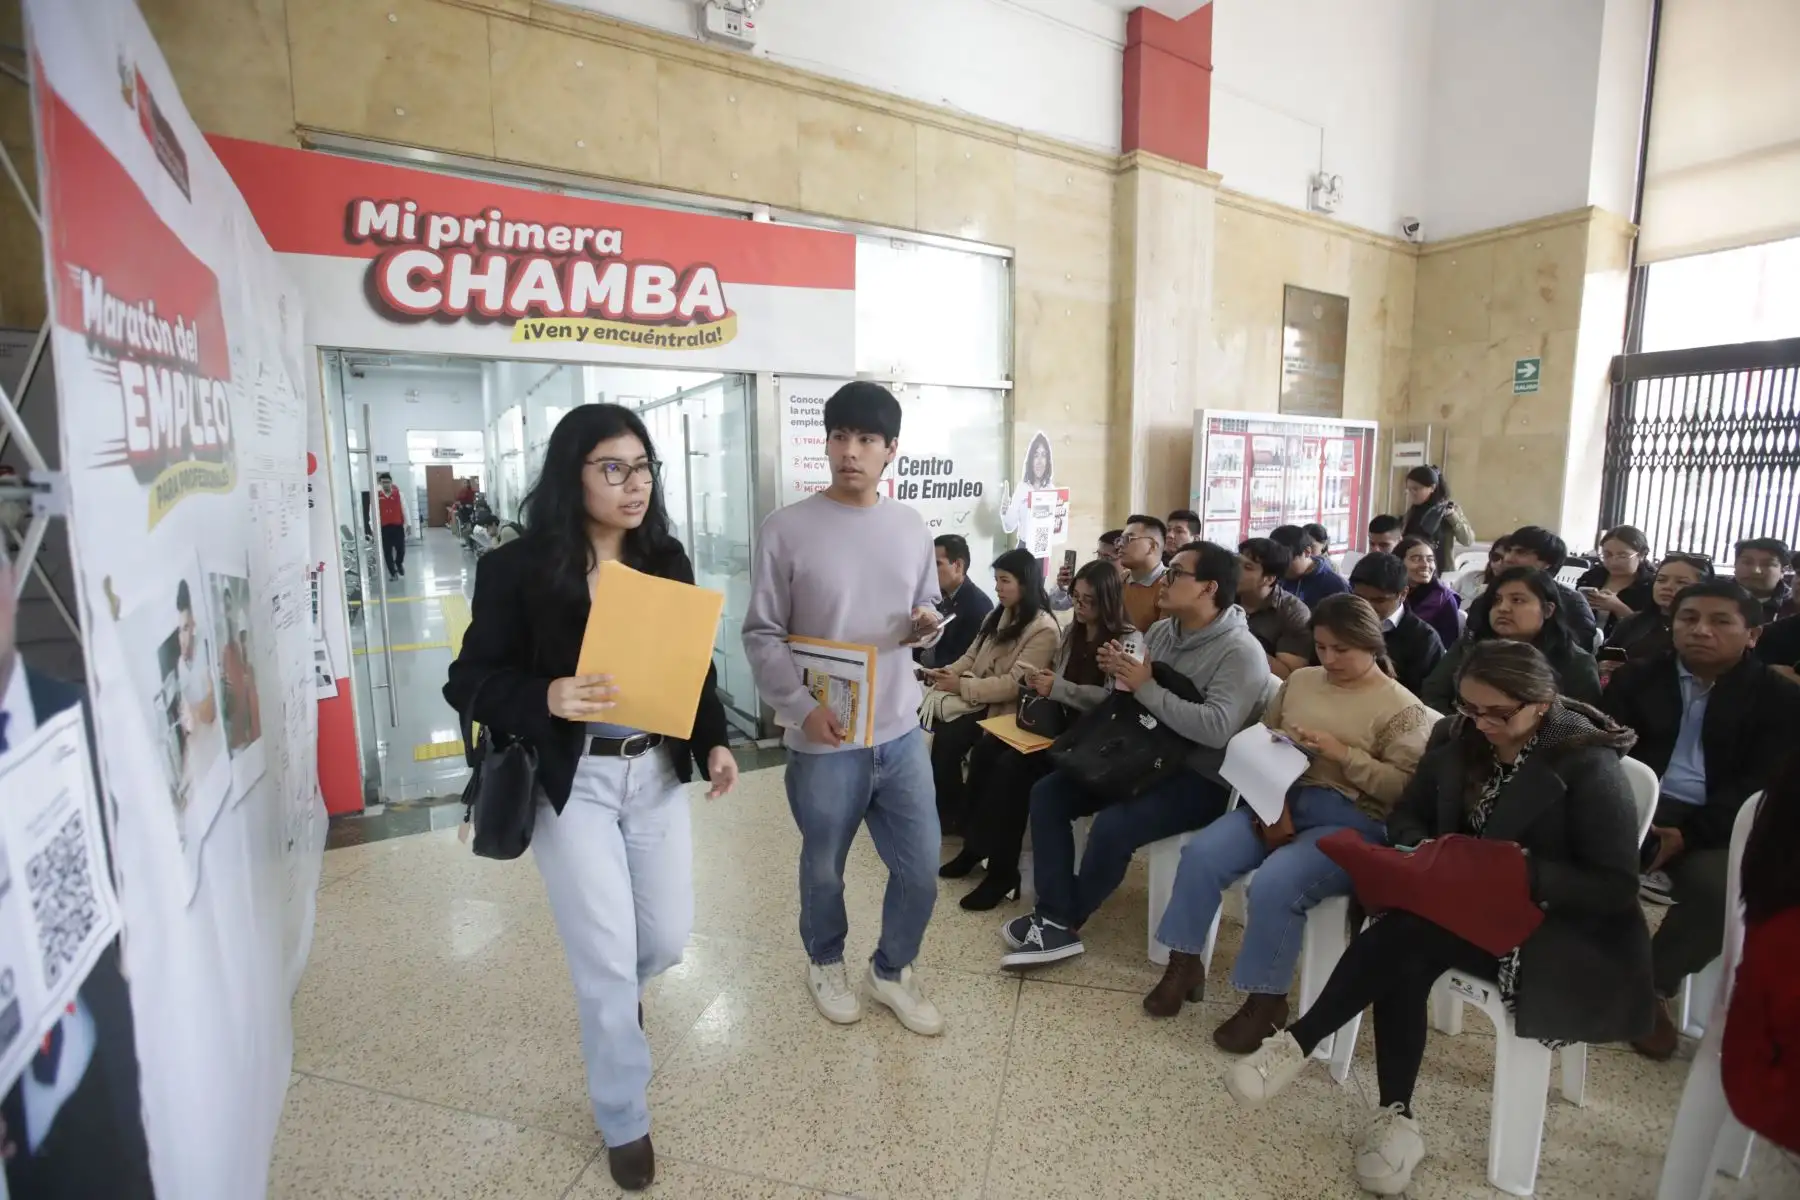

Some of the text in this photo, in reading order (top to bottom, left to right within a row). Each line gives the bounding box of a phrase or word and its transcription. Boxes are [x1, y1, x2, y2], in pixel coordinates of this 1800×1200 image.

[356, 200, 624, 256] Mi primera
[385, 248, 728, 319] CHAMBA
[82, 269, 199, 365] Maratón del
[523, 322, 723, 349] ¡Ven y encuéntrala!
[117, 358, 231, 452] EMPLEO
[789, 395, 825, 405] Conoce
[789, 406, 820, 415] la ruta
[813, 462, 826, 470] CV
[897, 455, 954, 477] Centro
[897, 478, 984, 501] de Empleo
[929, 519, 943, 528] CV
